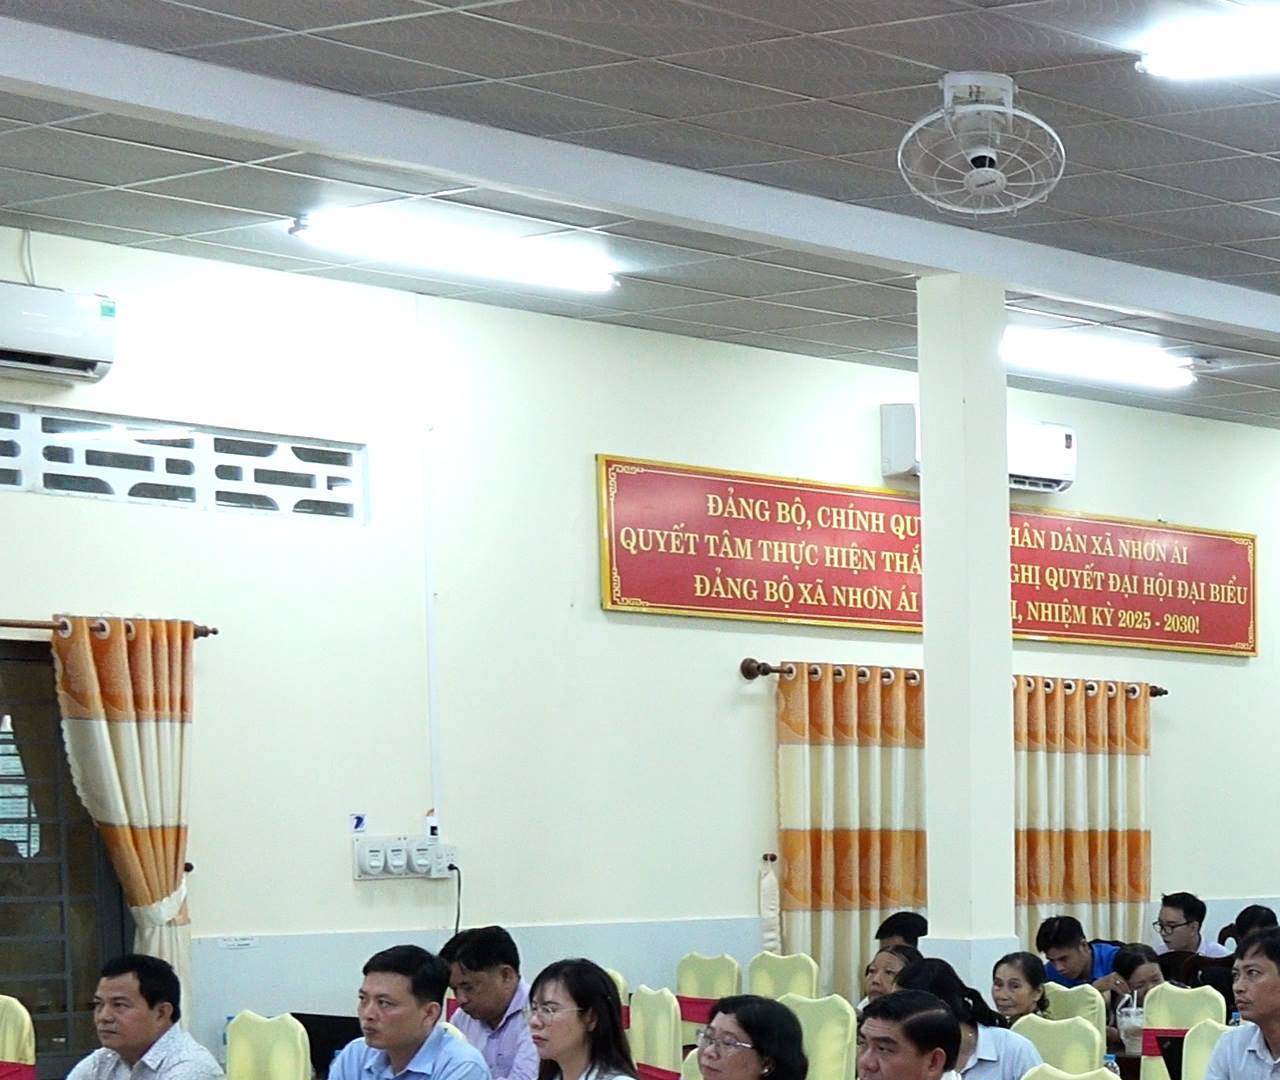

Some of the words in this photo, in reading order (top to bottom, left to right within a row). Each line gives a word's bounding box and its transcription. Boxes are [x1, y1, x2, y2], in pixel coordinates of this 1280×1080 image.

[620, 522, 699, 555] QUYẾT
[705, 530, 752, 560] TÂM
[757, 540, 818, 570] THỰC
[824, 542, 876, 574] HIỆN
[881, 544, 922, 575] THẮ
[1009, 563, 1040, 590] GHỊ
[1045, 563, 1104, 591] QUYẾT
[1108, 574, 1137, 598] ĐẠI
[1143, 573, 1172, 601] HỘI
[1177, 581, 1205, 604] ĐẠI
[1209, 575, 1248, 605] BIỂU
[706, 487, 770, 522] ĐẢNG
[776, 497, 812, 531] BỘ,
[817, 502, 885, 533] CHÍNH
[890, 513, 922, 538] QU
[1009, 522, 1045, 549] HÂN
[1051, 527, 1087, 553] DÂN
[1091, 532, 1114, 558] XÃ
[1118, 538, 1167, 563] NHƠN
[1172, 542, 1188, 566] ÁI
[694, 567, 758, 601] ĐẢNG
[764, 577, 794, 608] BỘ
[798, 580, 828, 606] XÃ
[832, 585, 893, 611] NHƠN
[896, 586, 918, 612] ÁI
[1027, 598, 1086, 628] NHIỆM
[1092, 602, 1114, 627] KỲ
[1118, 609, 1151, 630] 2025
[1164, 614, 1200, 634] 2030!
